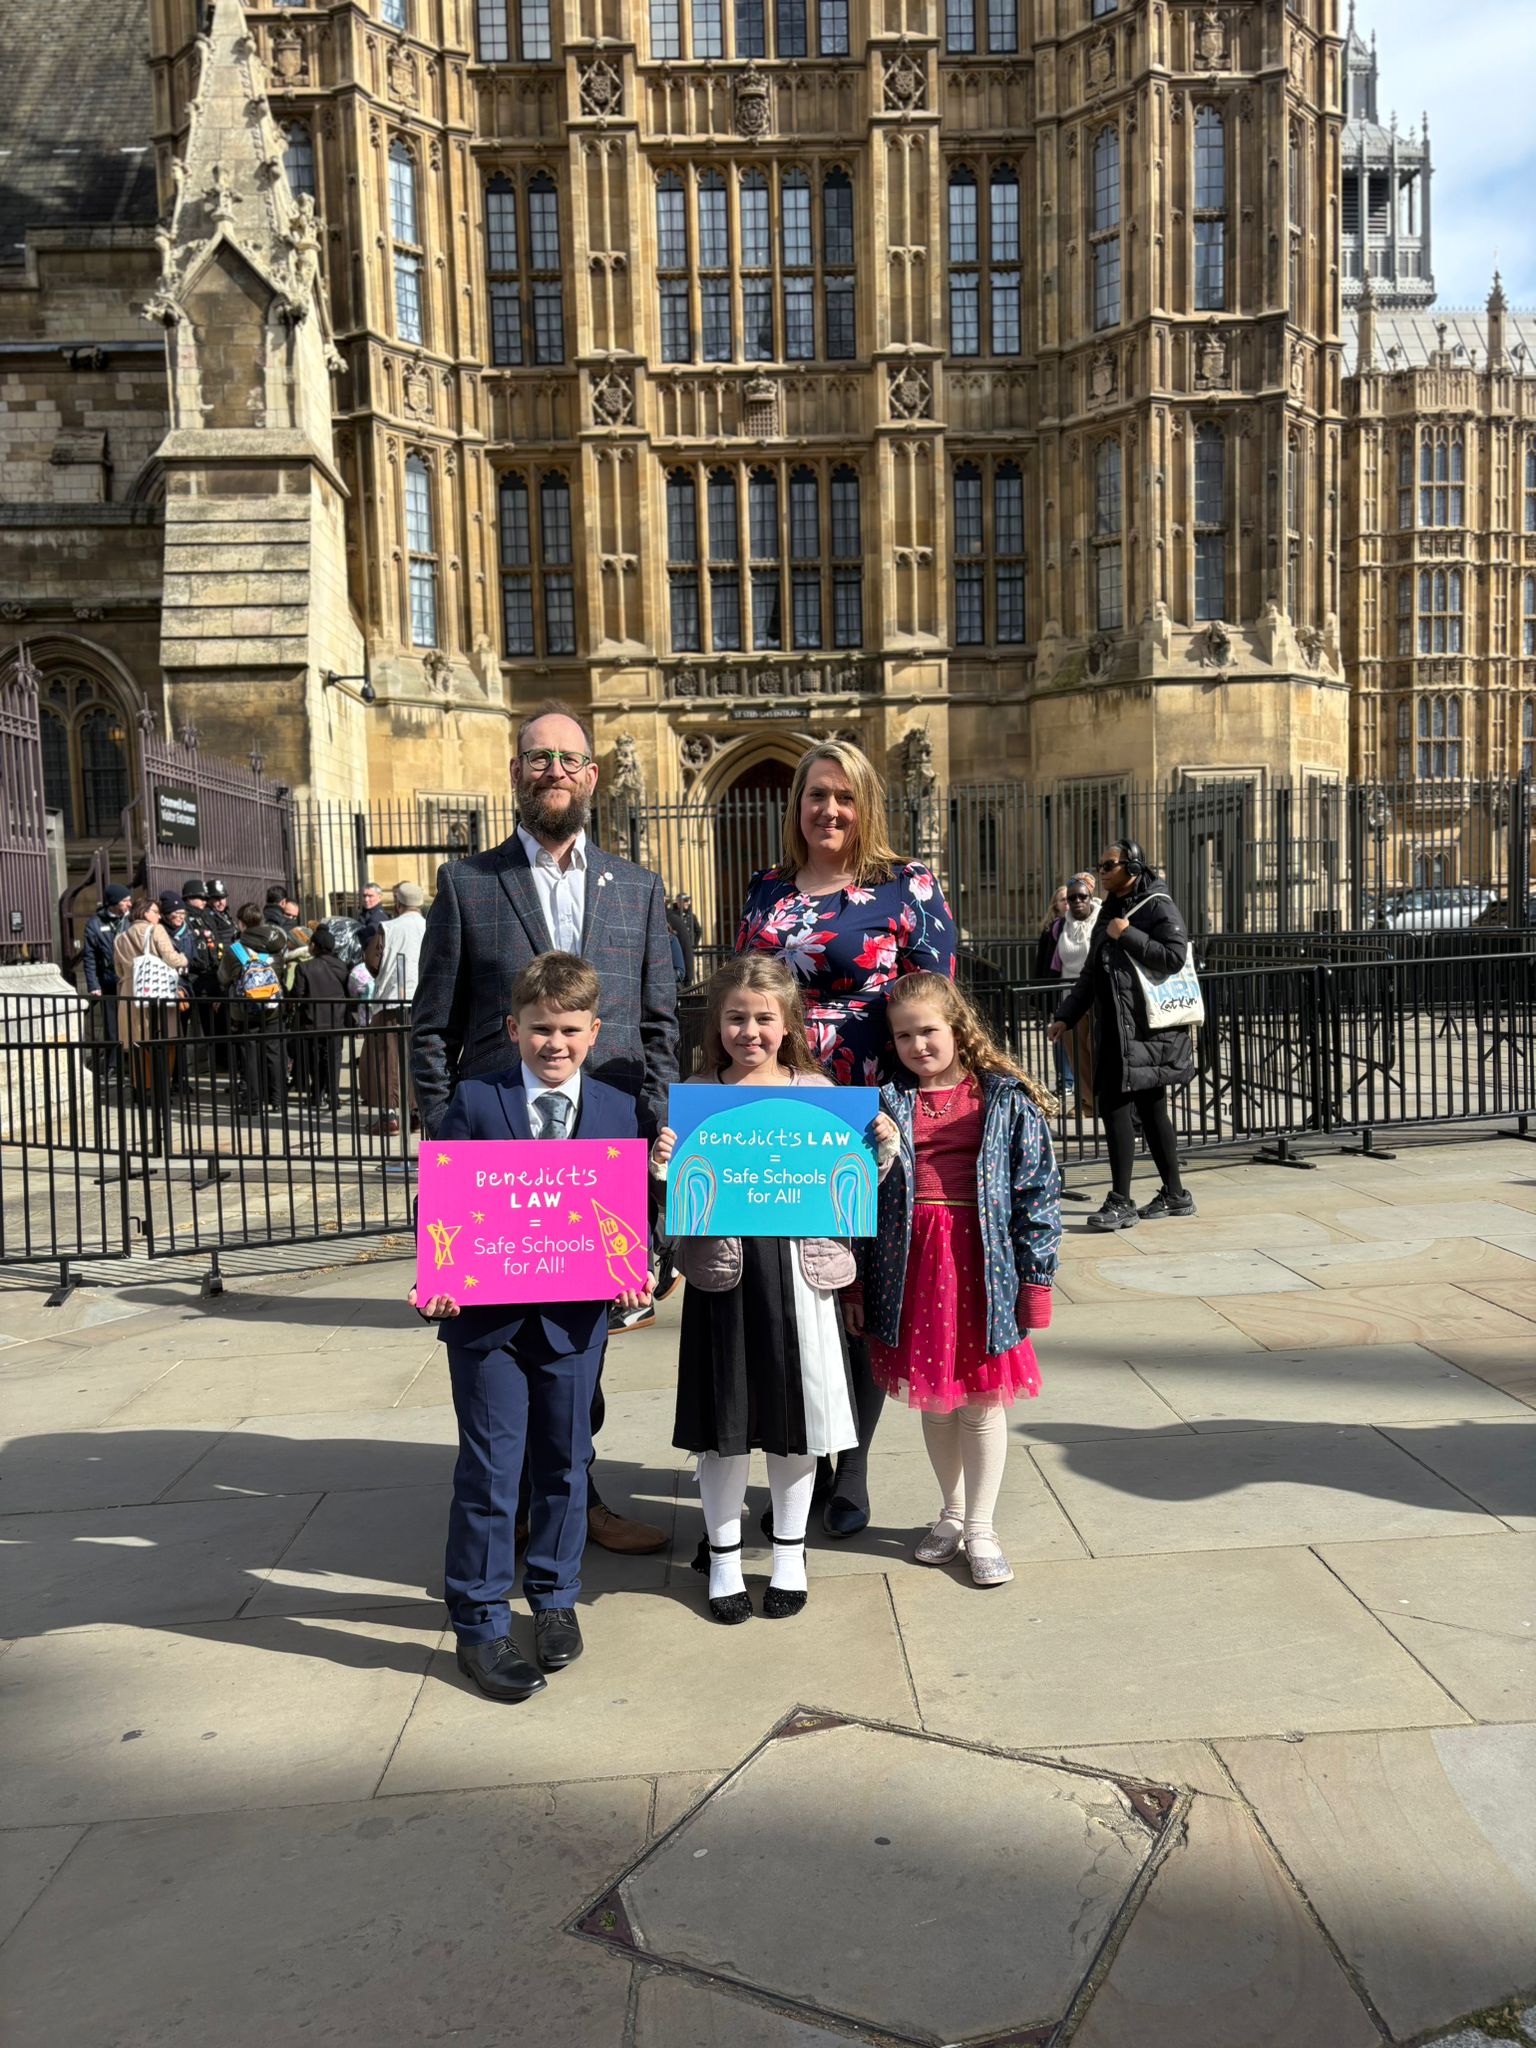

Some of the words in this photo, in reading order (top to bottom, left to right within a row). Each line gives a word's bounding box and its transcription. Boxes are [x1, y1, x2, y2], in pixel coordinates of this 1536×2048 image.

[699, 1128, 802, 1147] Benedict's
[807, 1131, 851, 1146] LAW
[476, 1164, 598, 1188] Benedict's
[722, 1168, 759, 1184] Safe
[763, 1168, 827, 1185] Schools
[510, 1191, 562, 1208] LAW
[747, 1187, 771, 1204] for
[774, 1188, 801, 1204] All!
[474, 1236, 516, 1255] Safe
[521, 1234, 595, 1254] Schools
[503, 1257, 530, 1275] for
[535, 1255, 566, 1274] All!
